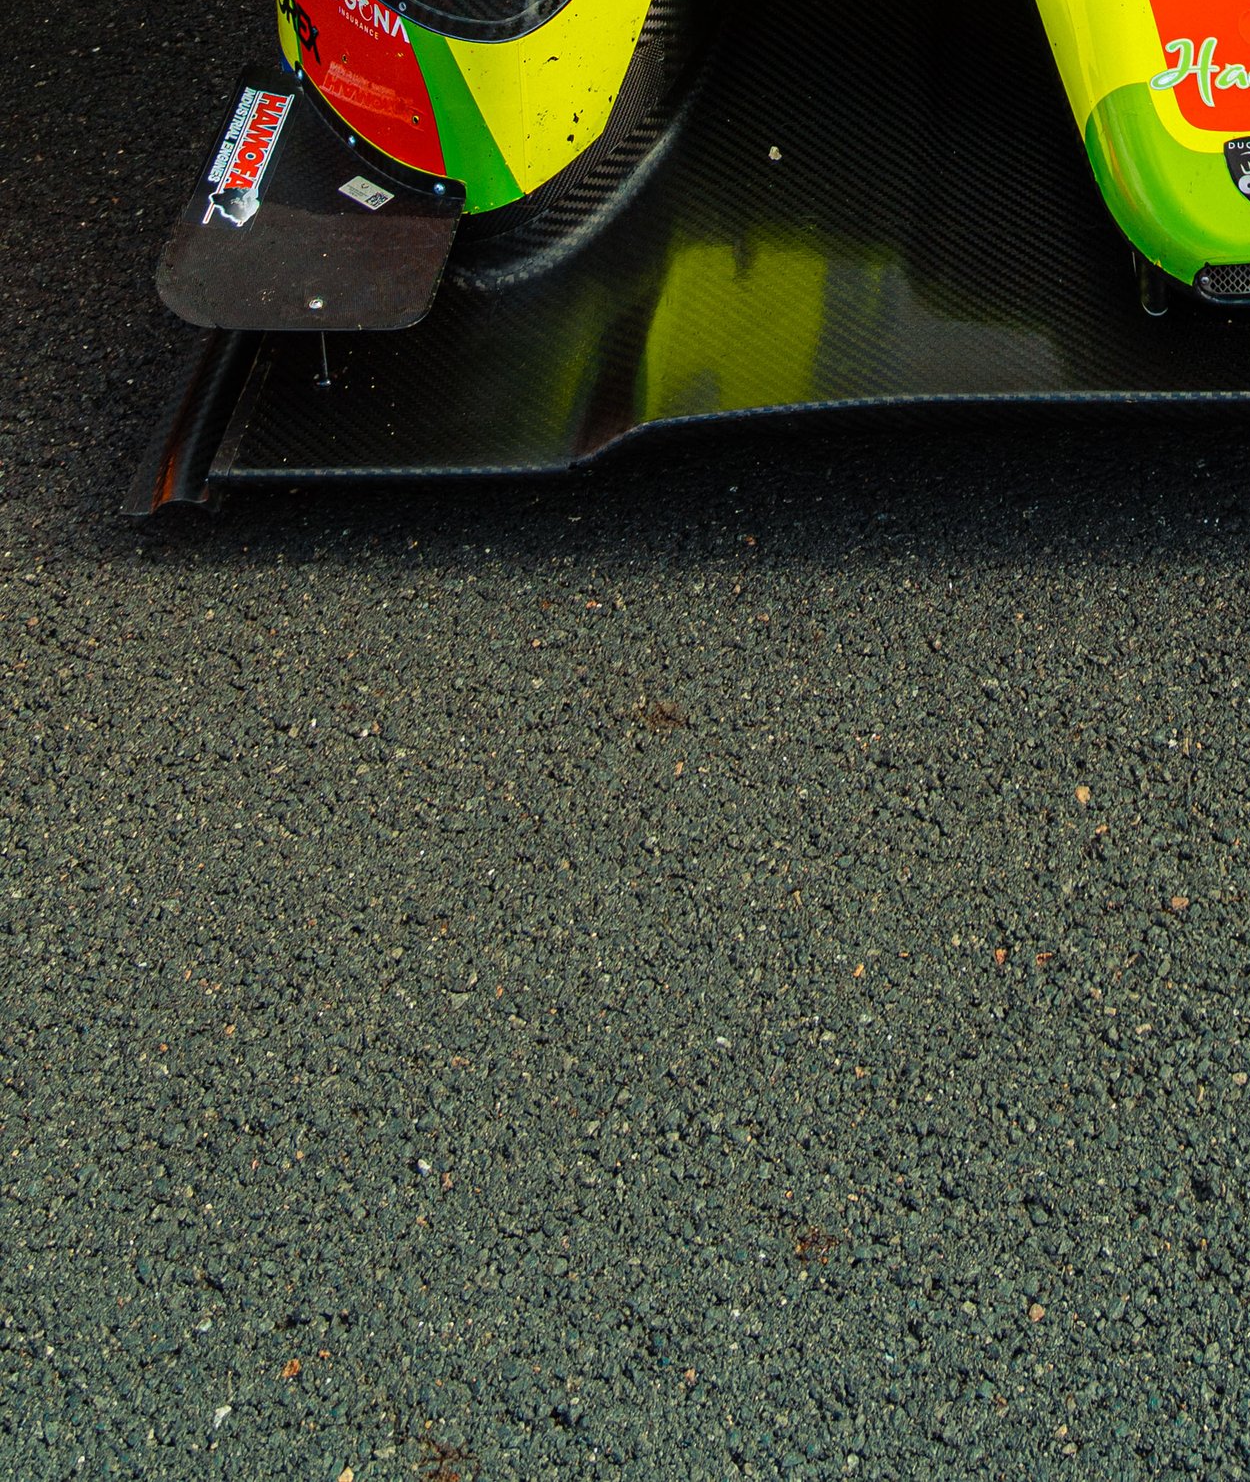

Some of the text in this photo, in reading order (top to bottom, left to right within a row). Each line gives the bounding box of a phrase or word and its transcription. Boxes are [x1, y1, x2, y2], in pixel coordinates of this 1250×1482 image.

[338, 6, 379, 40] INSURANCE
[207, 86, 257, 183] INDUSTRIAL ENGINES
[223, 92, 289, 189] HAMOFA
